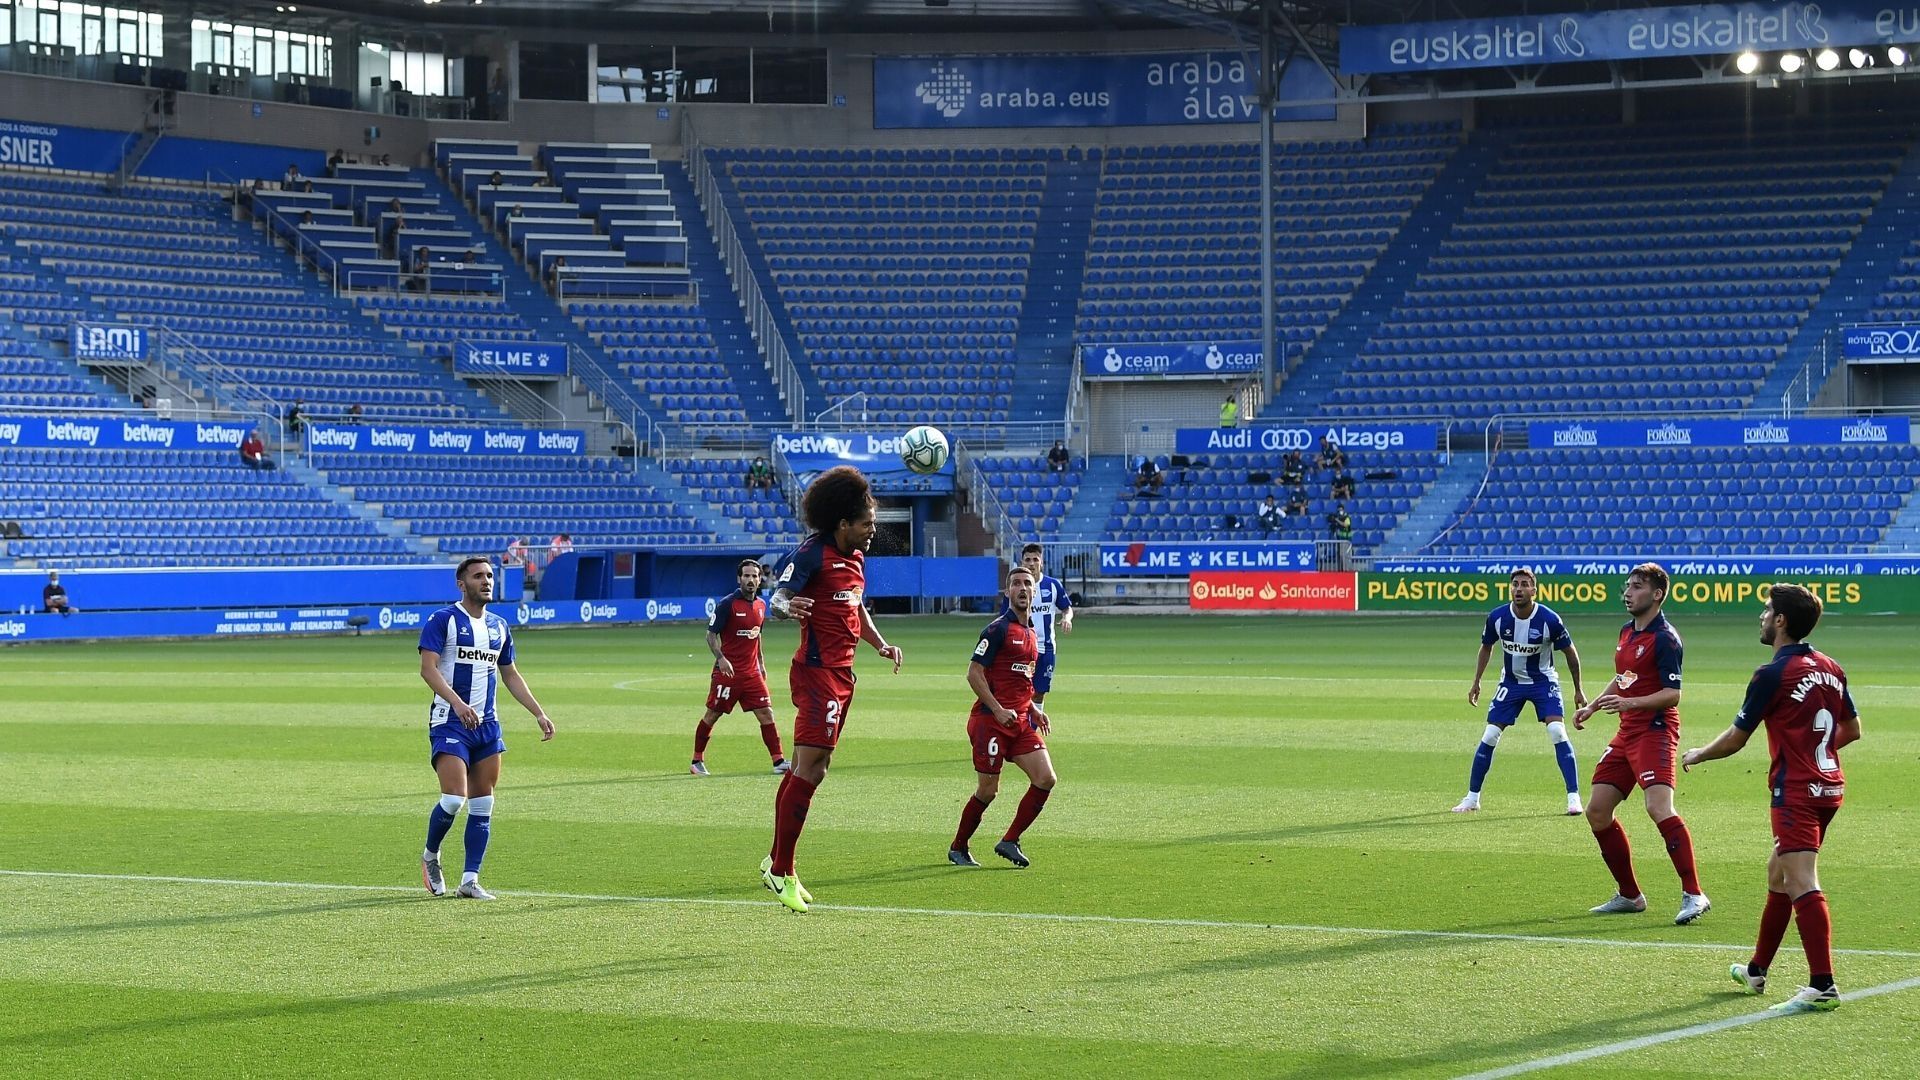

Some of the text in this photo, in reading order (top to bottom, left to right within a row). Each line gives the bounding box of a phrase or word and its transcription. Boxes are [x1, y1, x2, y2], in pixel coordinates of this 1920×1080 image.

[1628, 10, 1788, 51] euskaltel
[1390, 23, 1543, 65] euskaltel
[1148, 53, 1245, 86] araba
[980, 87, 1110, 108] araba.eus
[1184, 87, 1254, 119] álav
[0, 135, 54, 165] SNER
[469, 350, 532, 366] KELME
[1125, 355, 1169, 368] ceam
[47, 420, 99, 446] betway
[124, 422, 174, 447] betway
[197, 424, 245, 448] betway
[312, 426, 358, 450] betway
[371, 428, 415, 451] betway
[429, 430, 471, 452] betway
[485, 431, 526, 452] betway
[1208, 427, 1404, 450] Audi Alzaga
[1554, 430, 1598, 442] FORONDA
[1647, 429, 1691, 441] FORONDA
[1744, 427, 1789, 439] FORONDA
[1842, 425, 1887, 438] FORONDA
[538, 432, 579, 453] betway
[776, 434, 851, 454] betway
[867, 435, 902, 454] bet
[1210, 551, 1290, 567] KELME
[1211, 583, 1254, 599] LaLiga
[1281, 584, 1351, 598] Santander
[1368, 578, 1606, 602] PLÁSTICOS TNICOS
[1672, 582, 1861, 604] COMPOTES
[393, 611, 420, 625] LaLiga
[530, 606, 555, 620] LaLiga
[593, 604, 617, 618] LaLiga
[658, 602, 681, 616] LaLiga
[1031, 604, 1051, 614] tway
[458, 647, 498, 665] betway
[1502, 641, 1541, 655] betway
[716, 684, 731, 700] 14
[1791, 671, 1822, 702] NACHO
[988, 737, 998, 756] 6
[1813, 708, 1839, 773] 2
